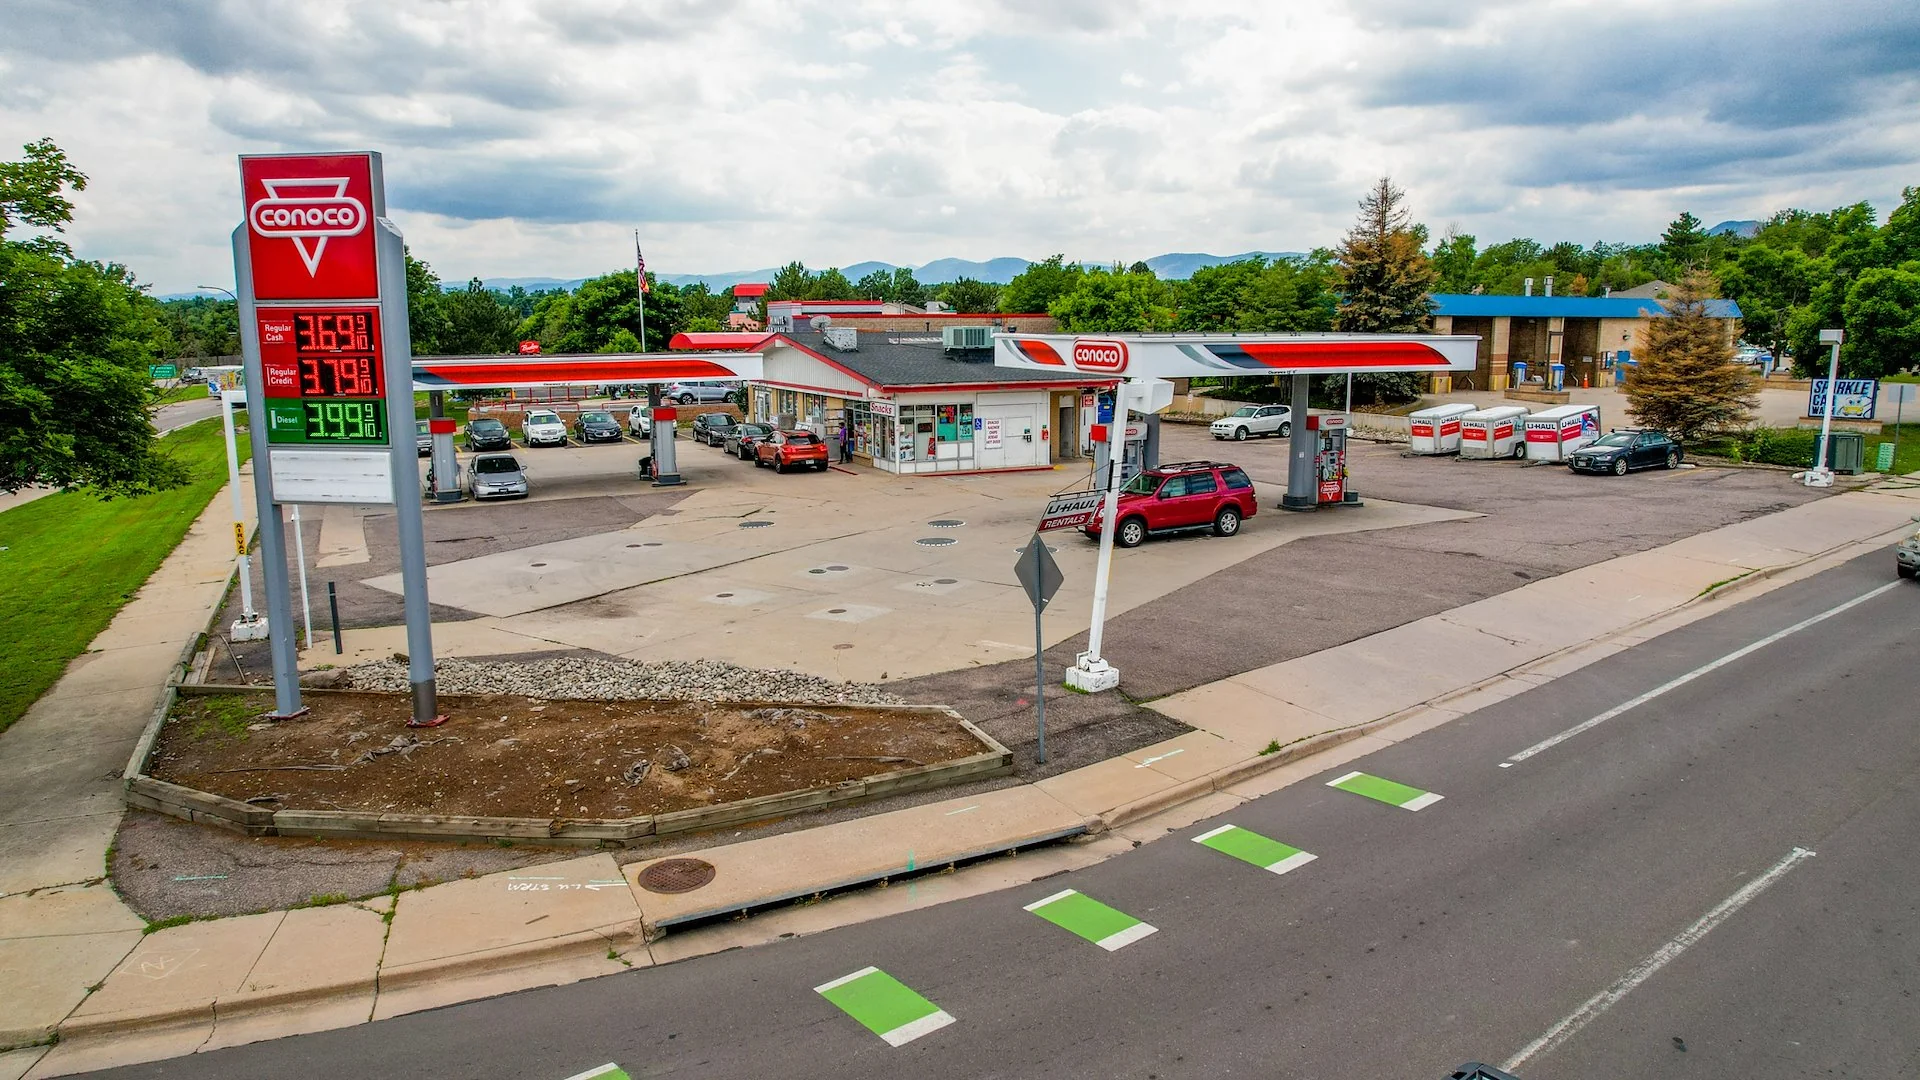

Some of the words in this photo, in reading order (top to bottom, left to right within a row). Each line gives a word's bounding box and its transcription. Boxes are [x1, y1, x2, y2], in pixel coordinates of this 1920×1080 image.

[260, 208, 355, 227] conoco
[264, 324, 291, 333] Regular
[266, 333, 283, 342] Cash
[1075, 348, 1119, 364] conoco
[270, 368, 296, 376] Regular
[271, 377, 293, 385] Credit
[1813, 394, 1836, 406] CA
[870, 401, 892, 414] Snacks
[277, 413, 298, 423] Diesel
[1048, 500, 1095, 514] U-HAUL
[1044, 515, 1086, 529] RENTALS
